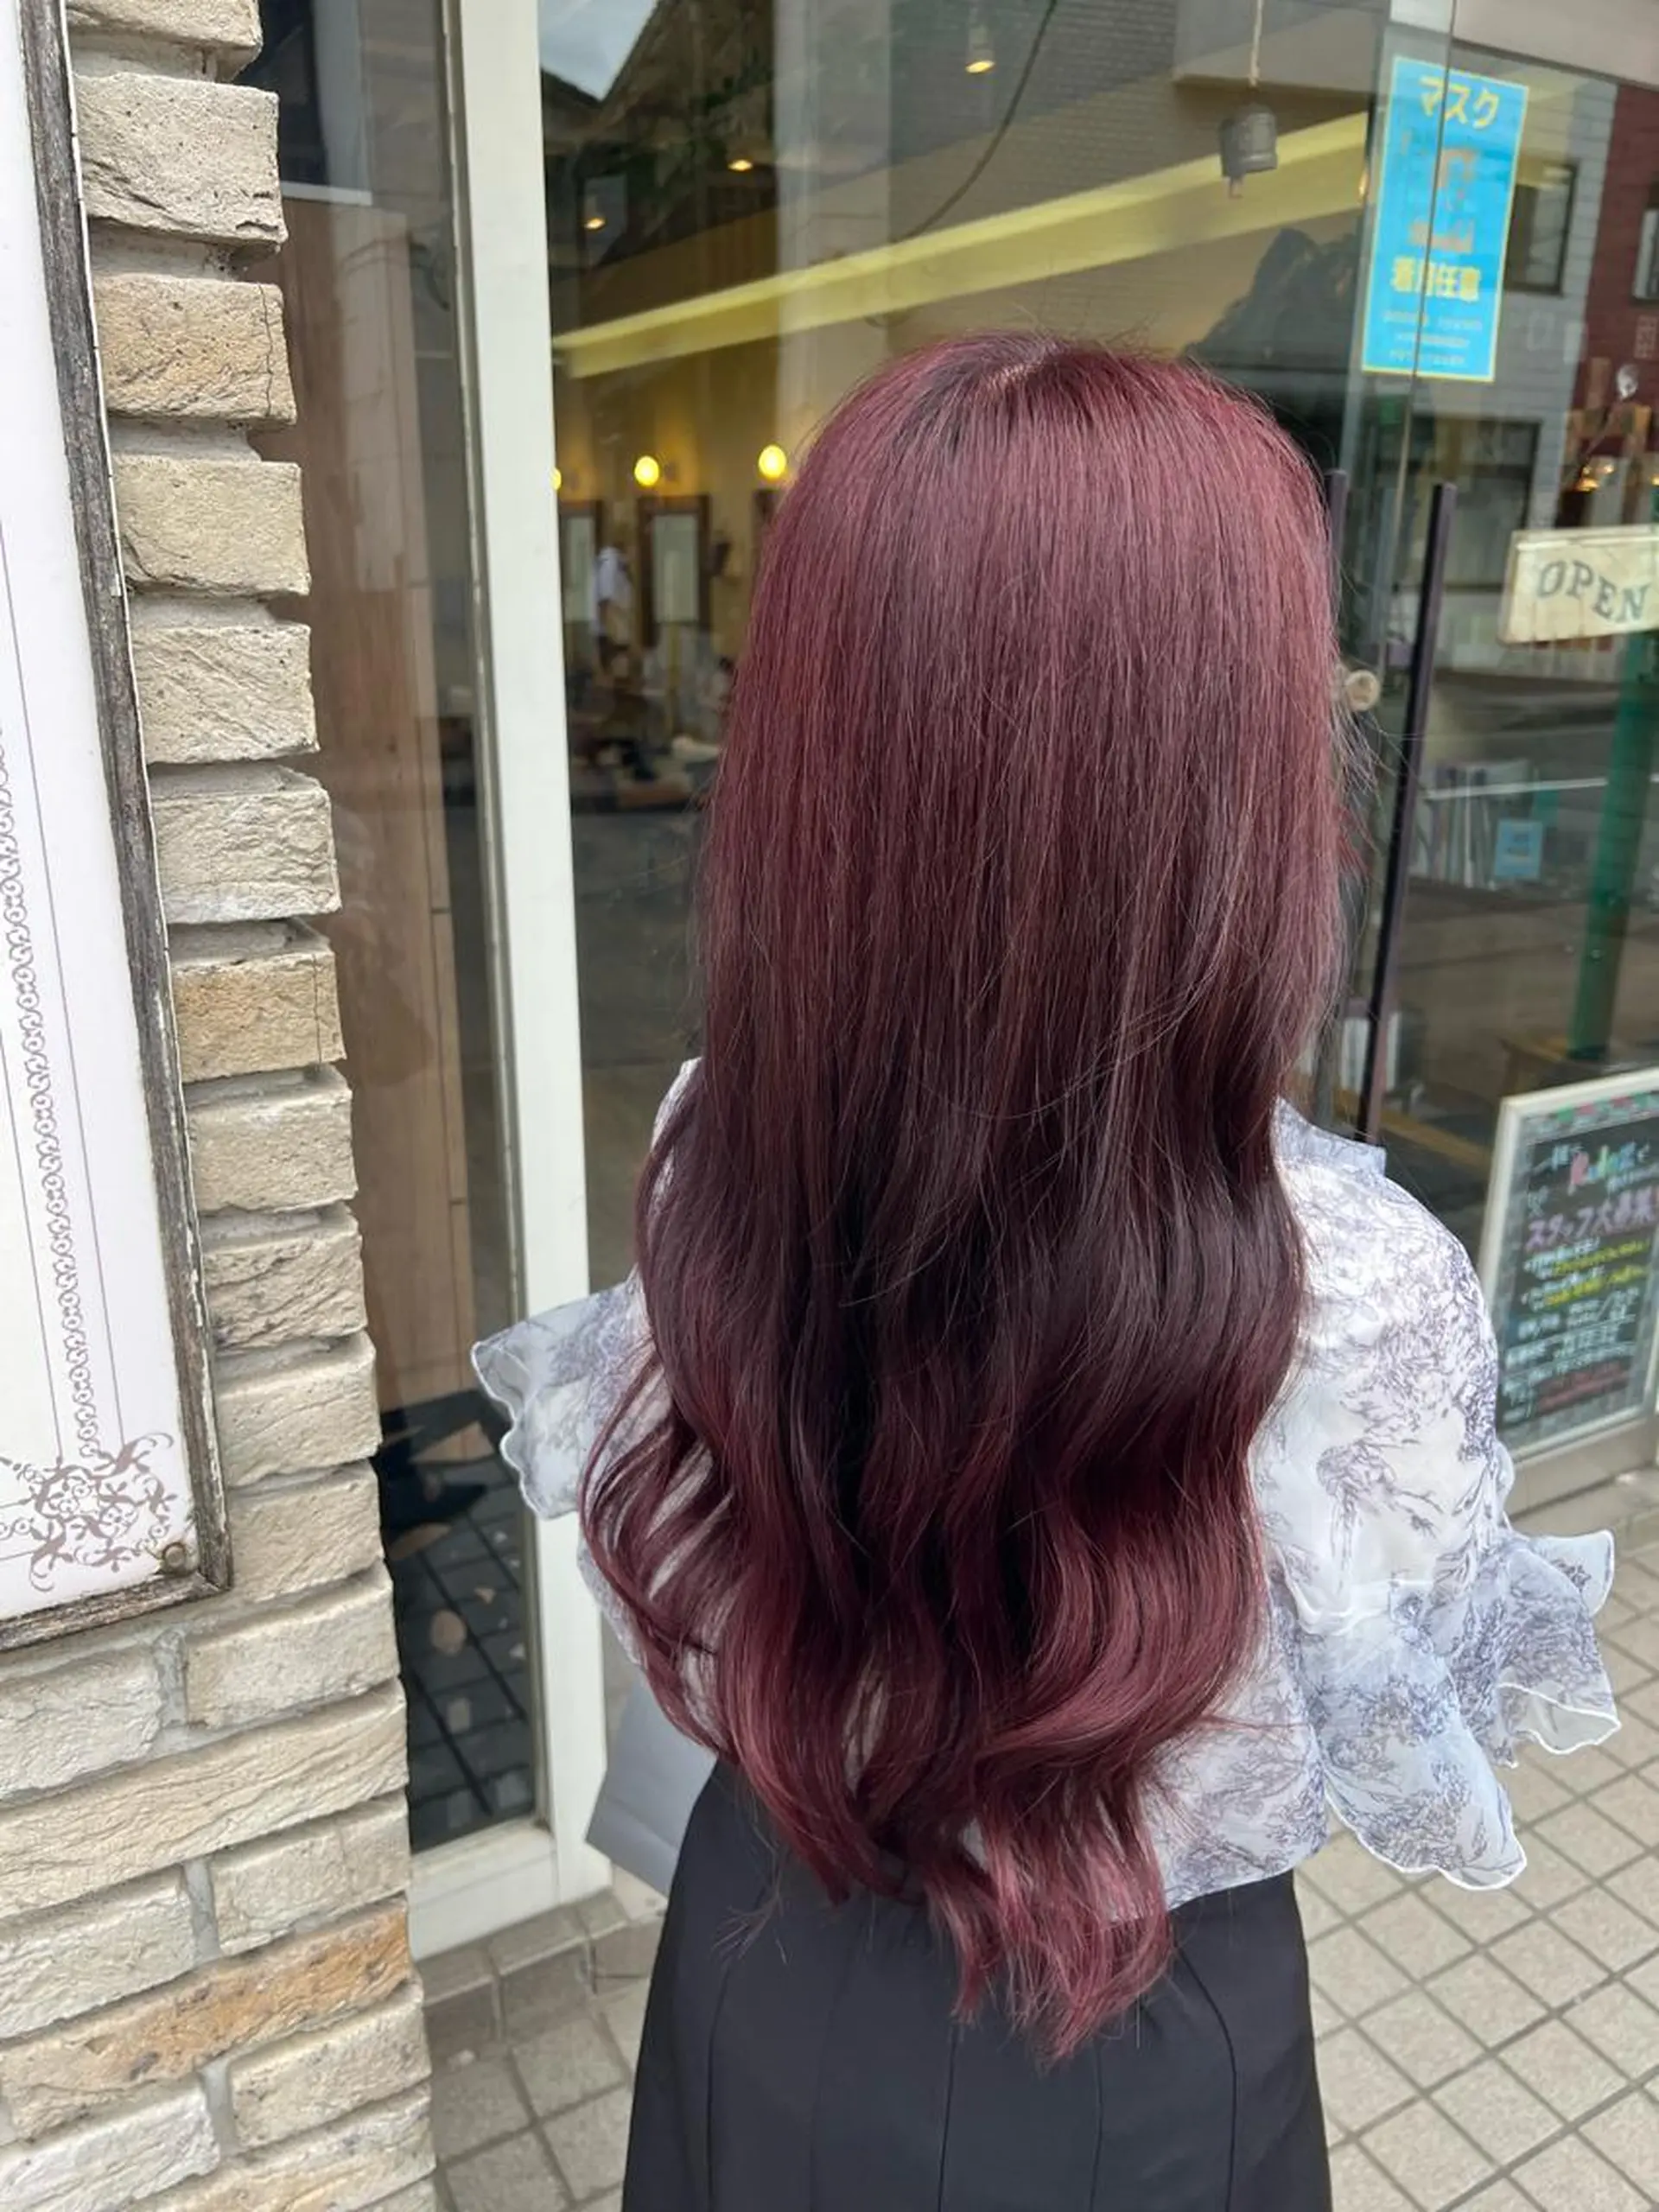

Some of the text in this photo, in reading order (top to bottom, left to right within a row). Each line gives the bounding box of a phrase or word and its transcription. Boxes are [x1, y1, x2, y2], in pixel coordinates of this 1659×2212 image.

[1419, 74, 1500, 129] マスク
[1537, 559, 1651, 623] OPEN
